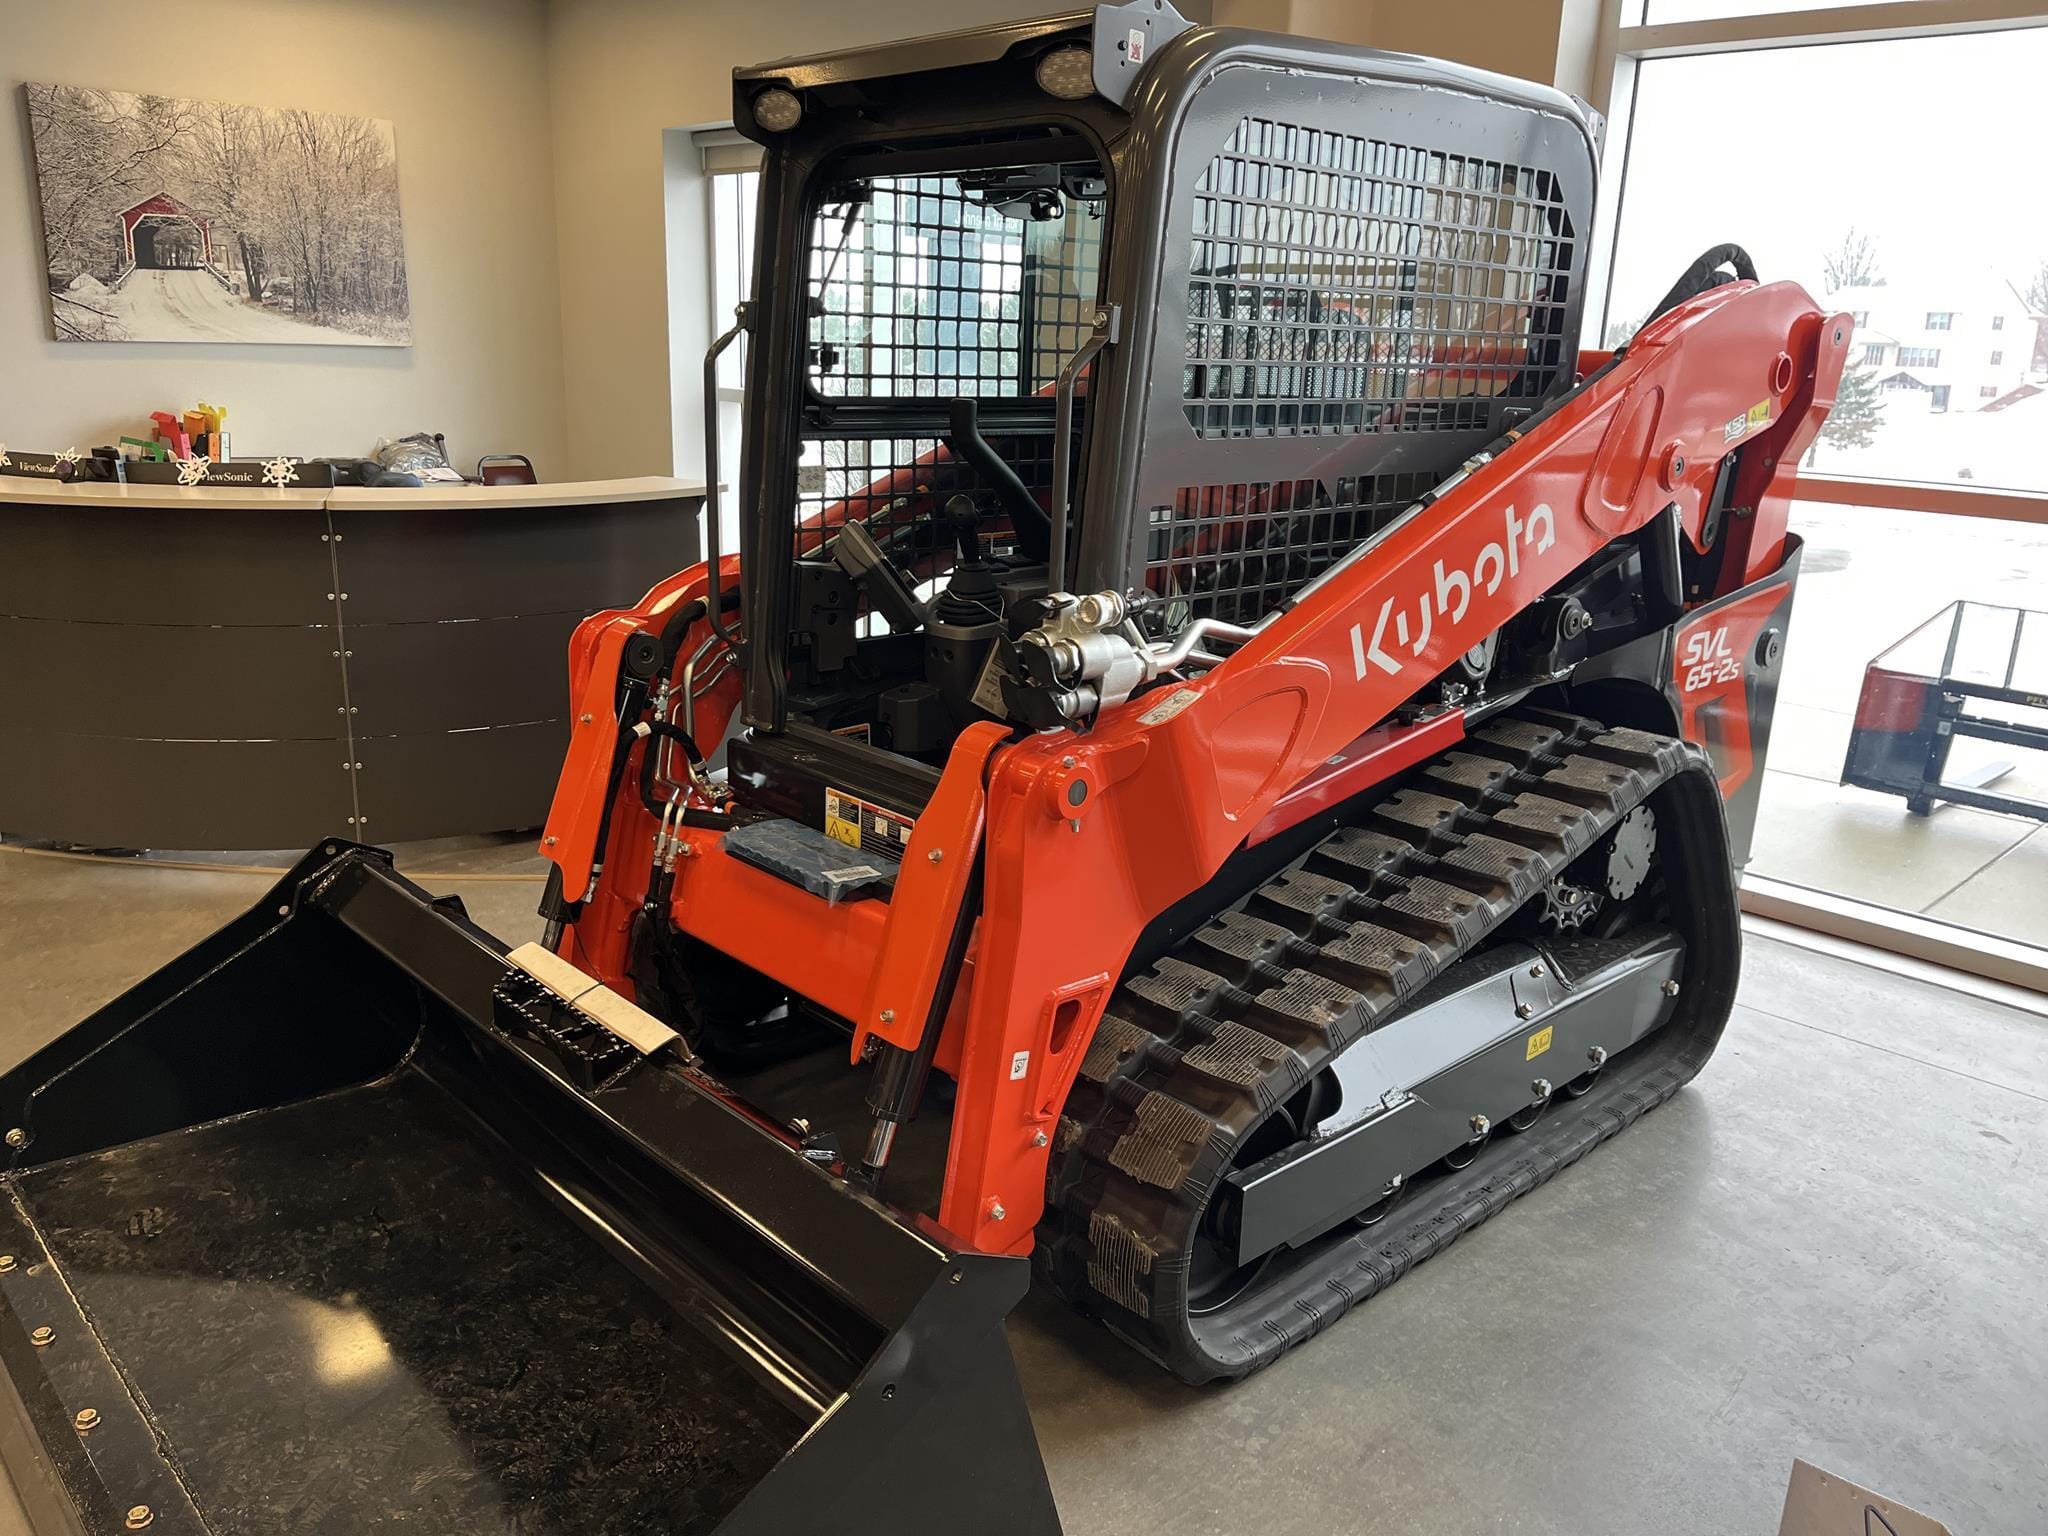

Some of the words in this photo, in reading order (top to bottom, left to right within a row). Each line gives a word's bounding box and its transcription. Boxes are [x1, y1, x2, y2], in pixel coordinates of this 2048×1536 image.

[954, 209, 991, 228] Jhnsn
[992, 213, 1018, 230] Trtor
[19, 461, 54, 473] ViewSon
[202, 472, 253, 482] iewSonic
[1350, 503, 1556, 682] Kubota
[1681, 626, 1732, 667] SVL
